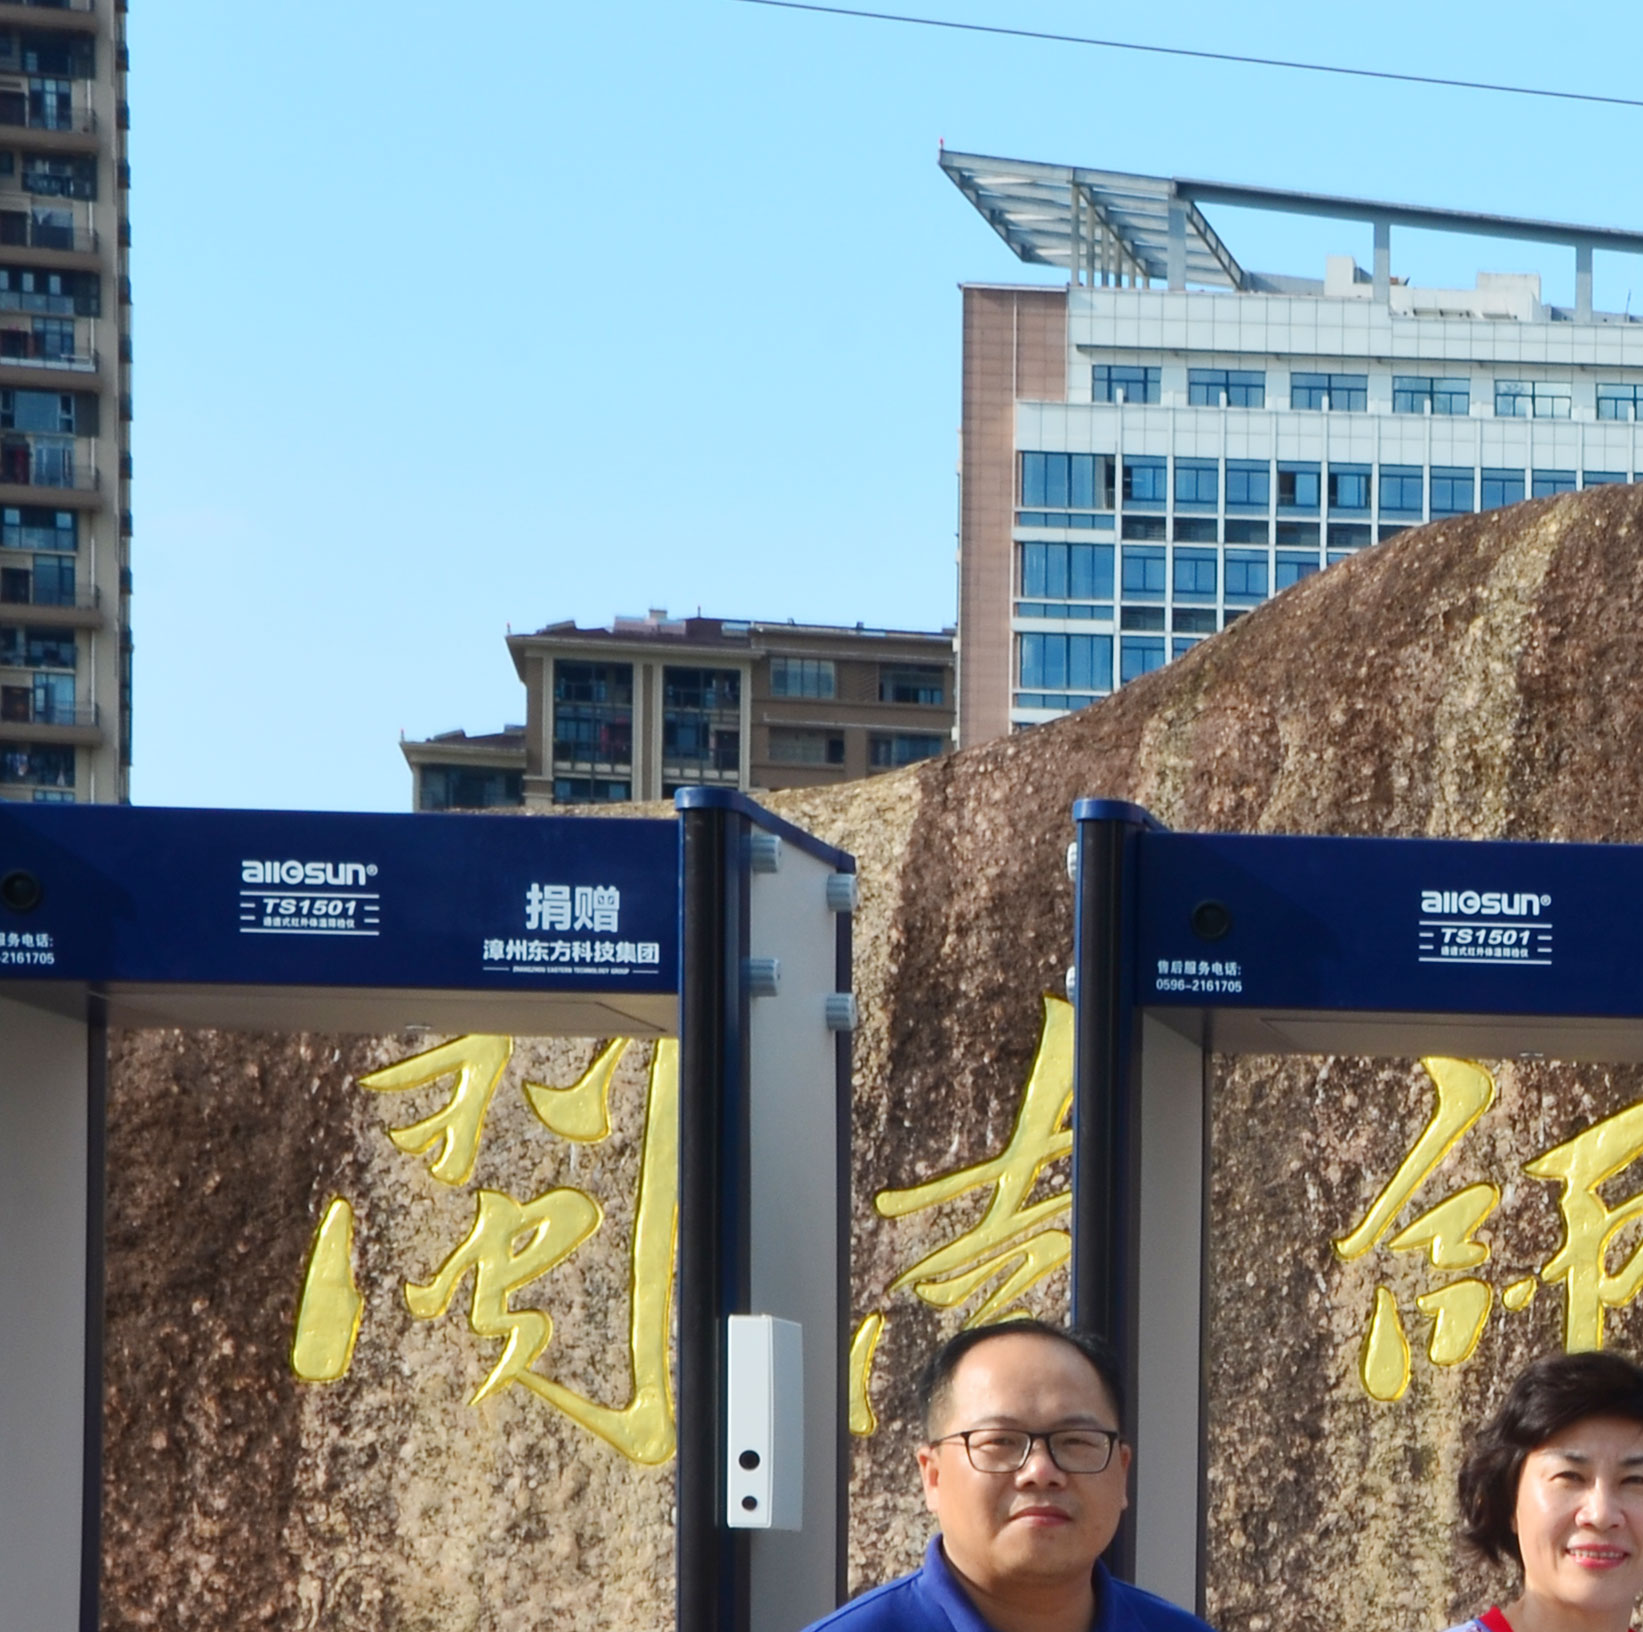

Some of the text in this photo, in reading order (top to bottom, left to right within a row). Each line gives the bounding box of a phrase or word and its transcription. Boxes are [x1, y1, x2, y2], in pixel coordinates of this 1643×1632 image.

[264, 899, 356, 915] TS1501
[526, 883, 619, 932] 捐赠
[1441, 928, 1530, 945] TS1501
[0, 951, 54, 964] 2161705
[484, 939, 659, 963] 漳州东方科技集团
[1156, 979, 1242, 992] 0596-2161705
